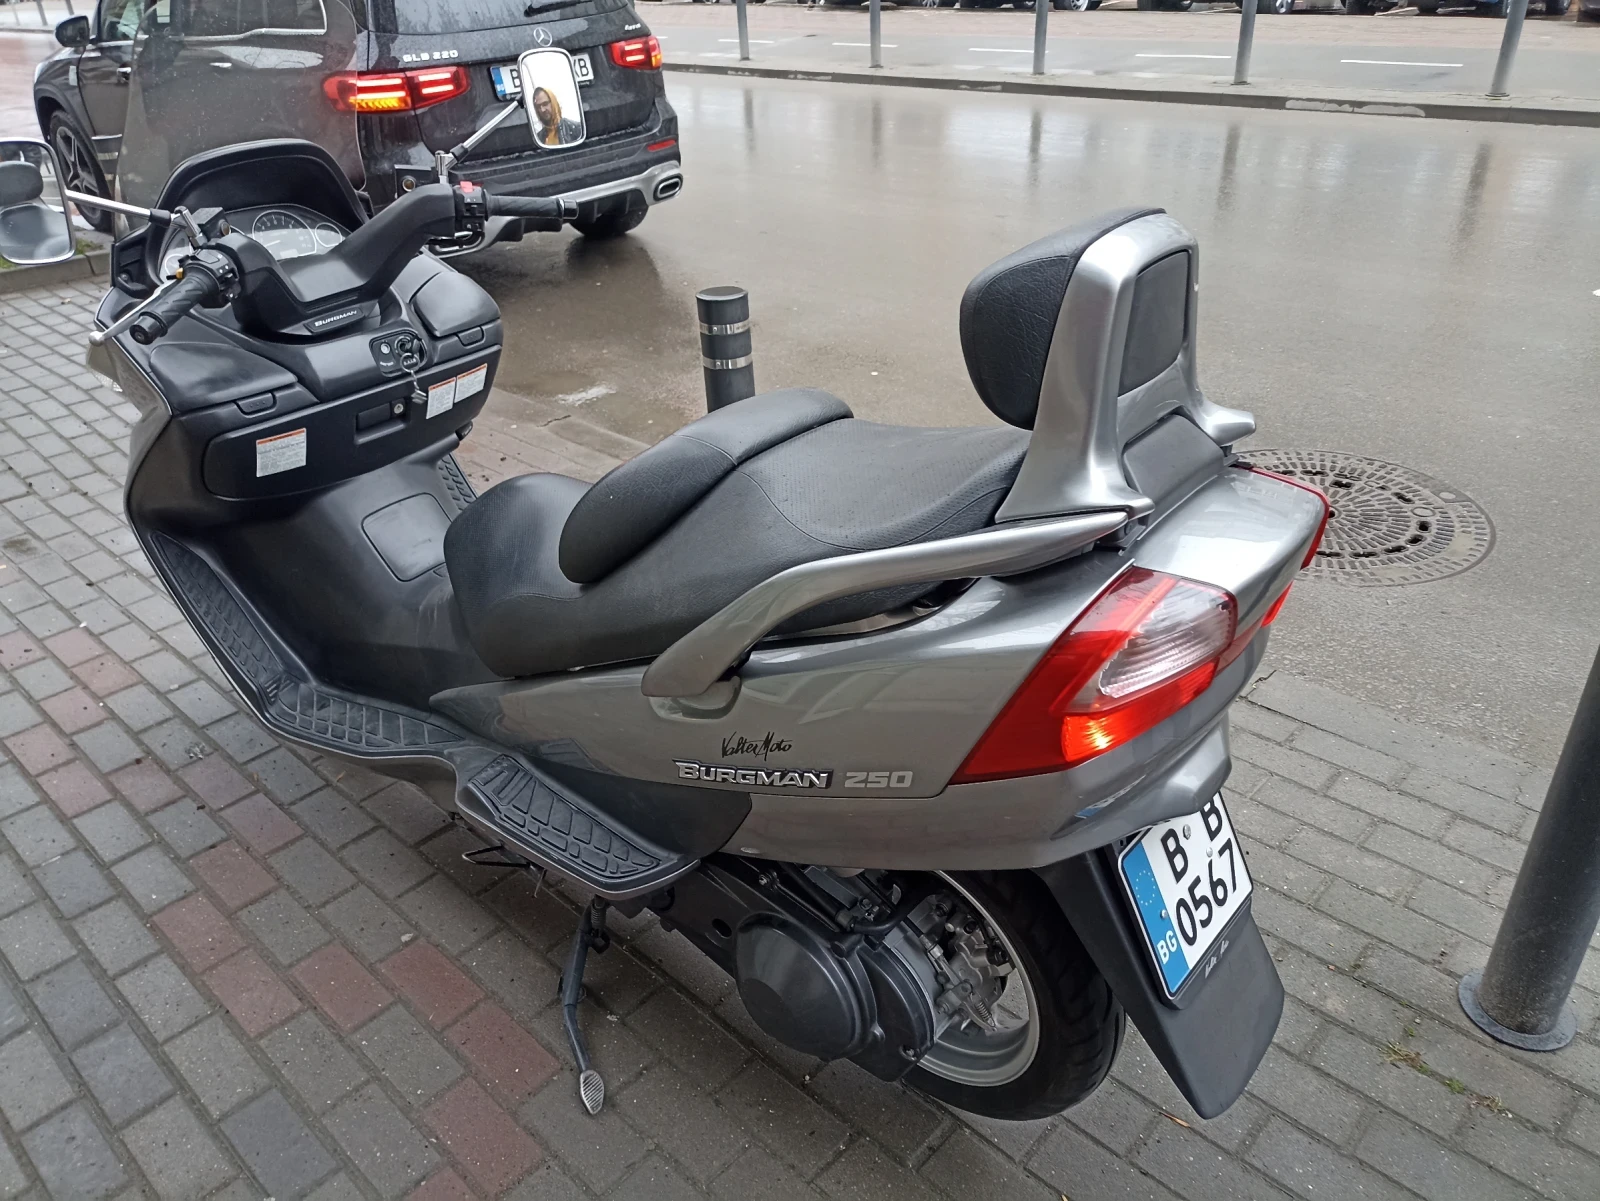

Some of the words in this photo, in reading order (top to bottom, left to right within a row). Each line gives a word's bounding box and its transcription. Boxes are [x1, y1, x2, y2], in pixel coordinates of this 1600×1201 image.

[432, 49, 459, 60] 220
[314, 309, 357, 327] BURGMAN
[672, 758, 834, 790] BURGMAN
[844, 770, 914, 789] 250
[1176, 838, 1236, 945] 0567
[1156, 930, 1178, 964] BG
